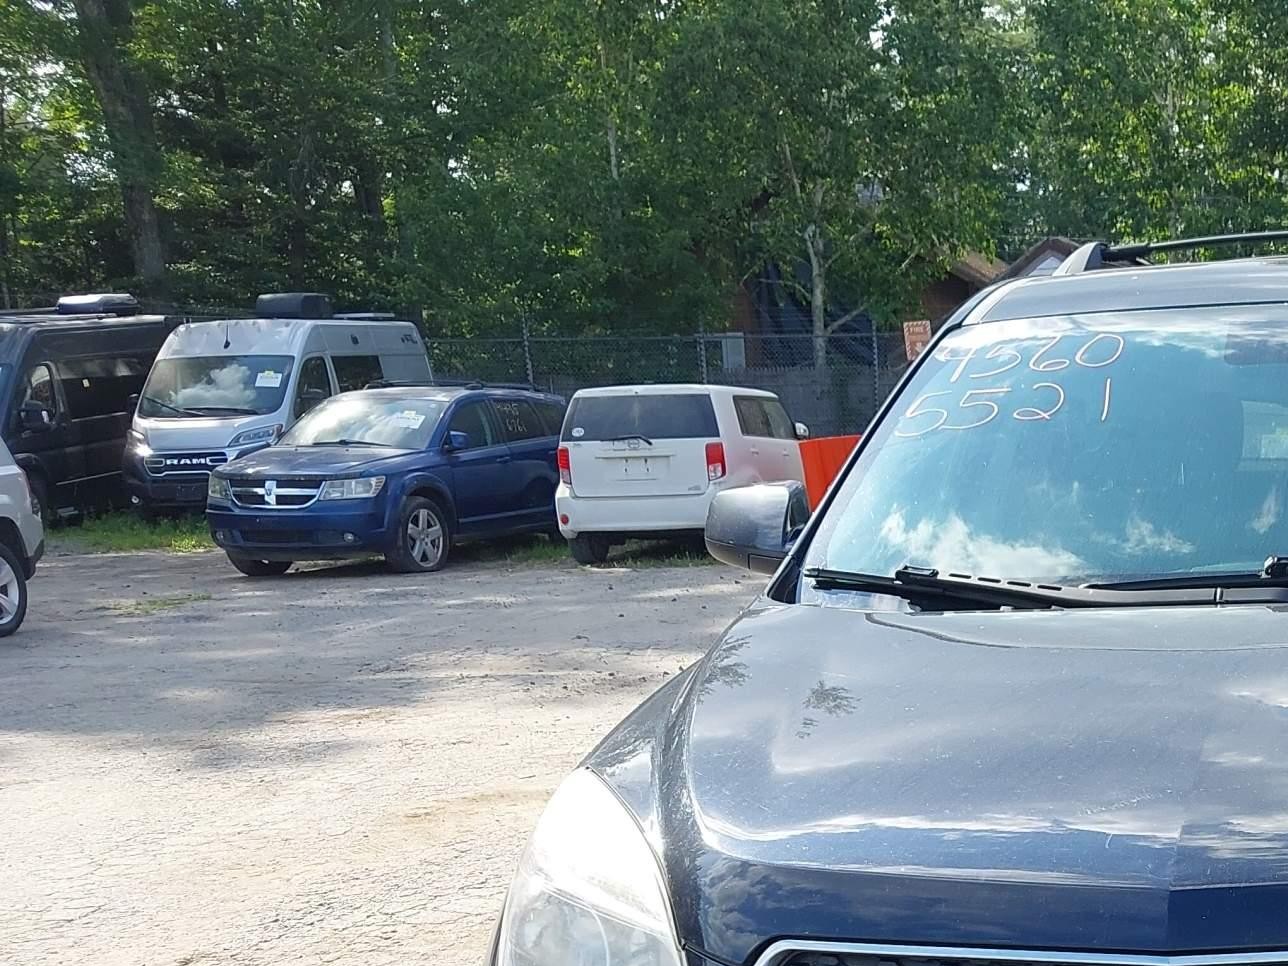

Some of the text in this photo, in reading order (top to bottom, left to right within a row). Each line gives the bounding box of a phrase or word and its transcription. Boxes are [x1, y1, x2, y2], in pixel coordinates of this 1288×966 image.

[933, 333, 1124, 383] 4560
[895, 378, 1111, 437] 5521
[166, 457, 206, 465] RAM
